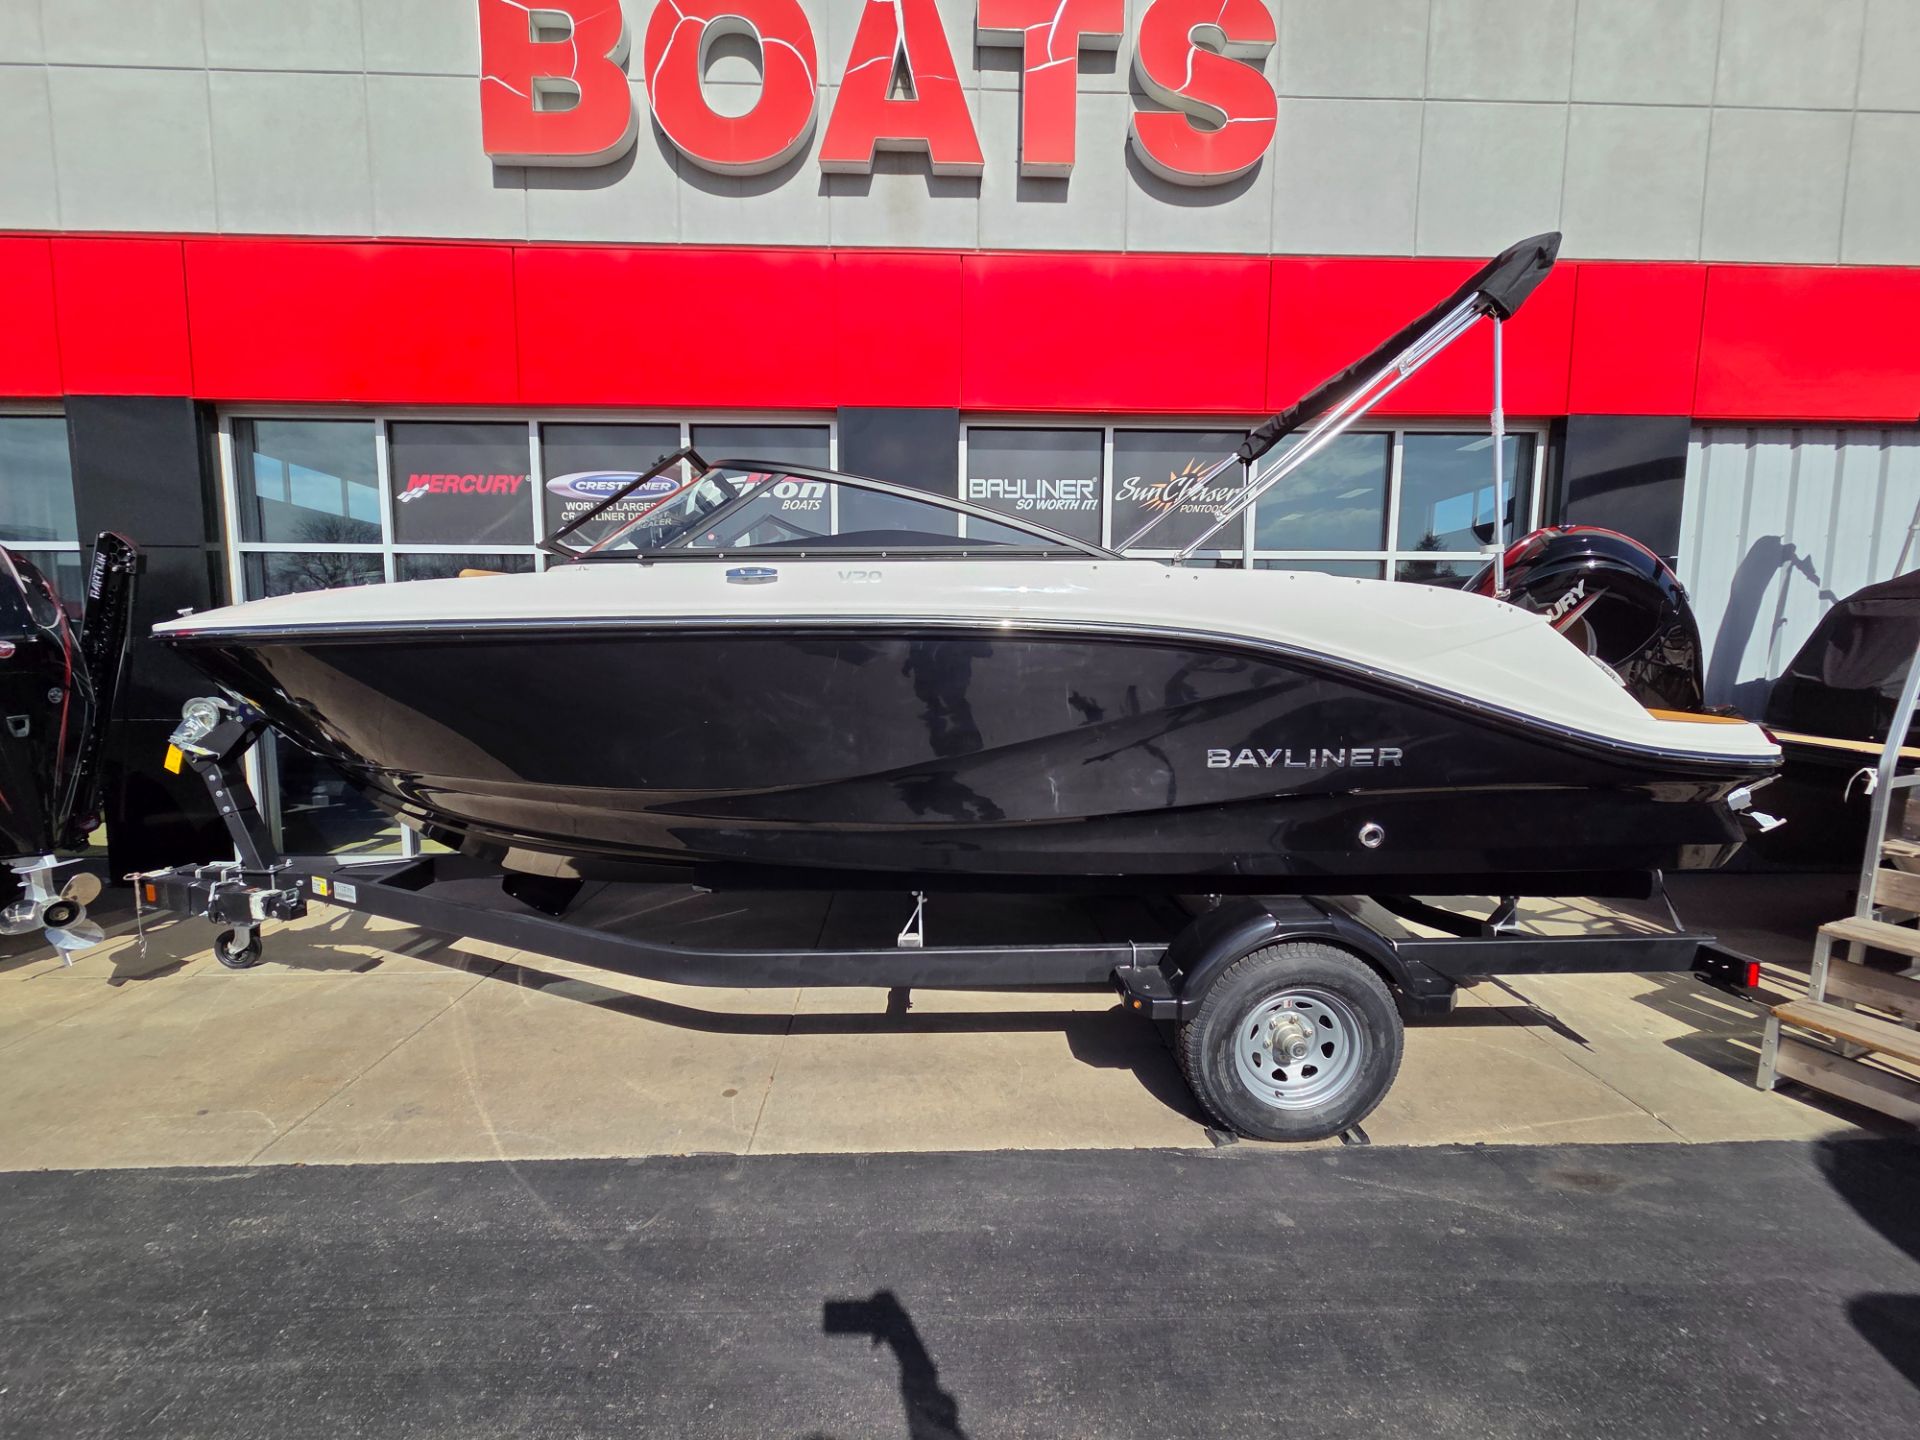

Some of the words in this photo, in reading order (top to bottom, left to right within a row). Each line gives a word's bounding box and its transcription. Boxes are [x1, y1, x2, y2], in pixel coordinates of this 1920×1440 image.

[481, 0, 1278, 184] BOATS
[406, 474, 524, 493] MERCURY
[575, 481, 671, 491] CRESTNER
[969, 479, 1093, 499] BAYLINER
[781, 500, 822, 510] BOATS
[1016, 499, 1034, 510] SO
[1036, 499, 1079, 510] WORTH
[1081, 499, 1099, 510] IT!
[1180, 504, 1231, 514] PONTOO
[1546, 578, 1585, 621] URY
[1207, 748, 1403, 768] BAYLINER
